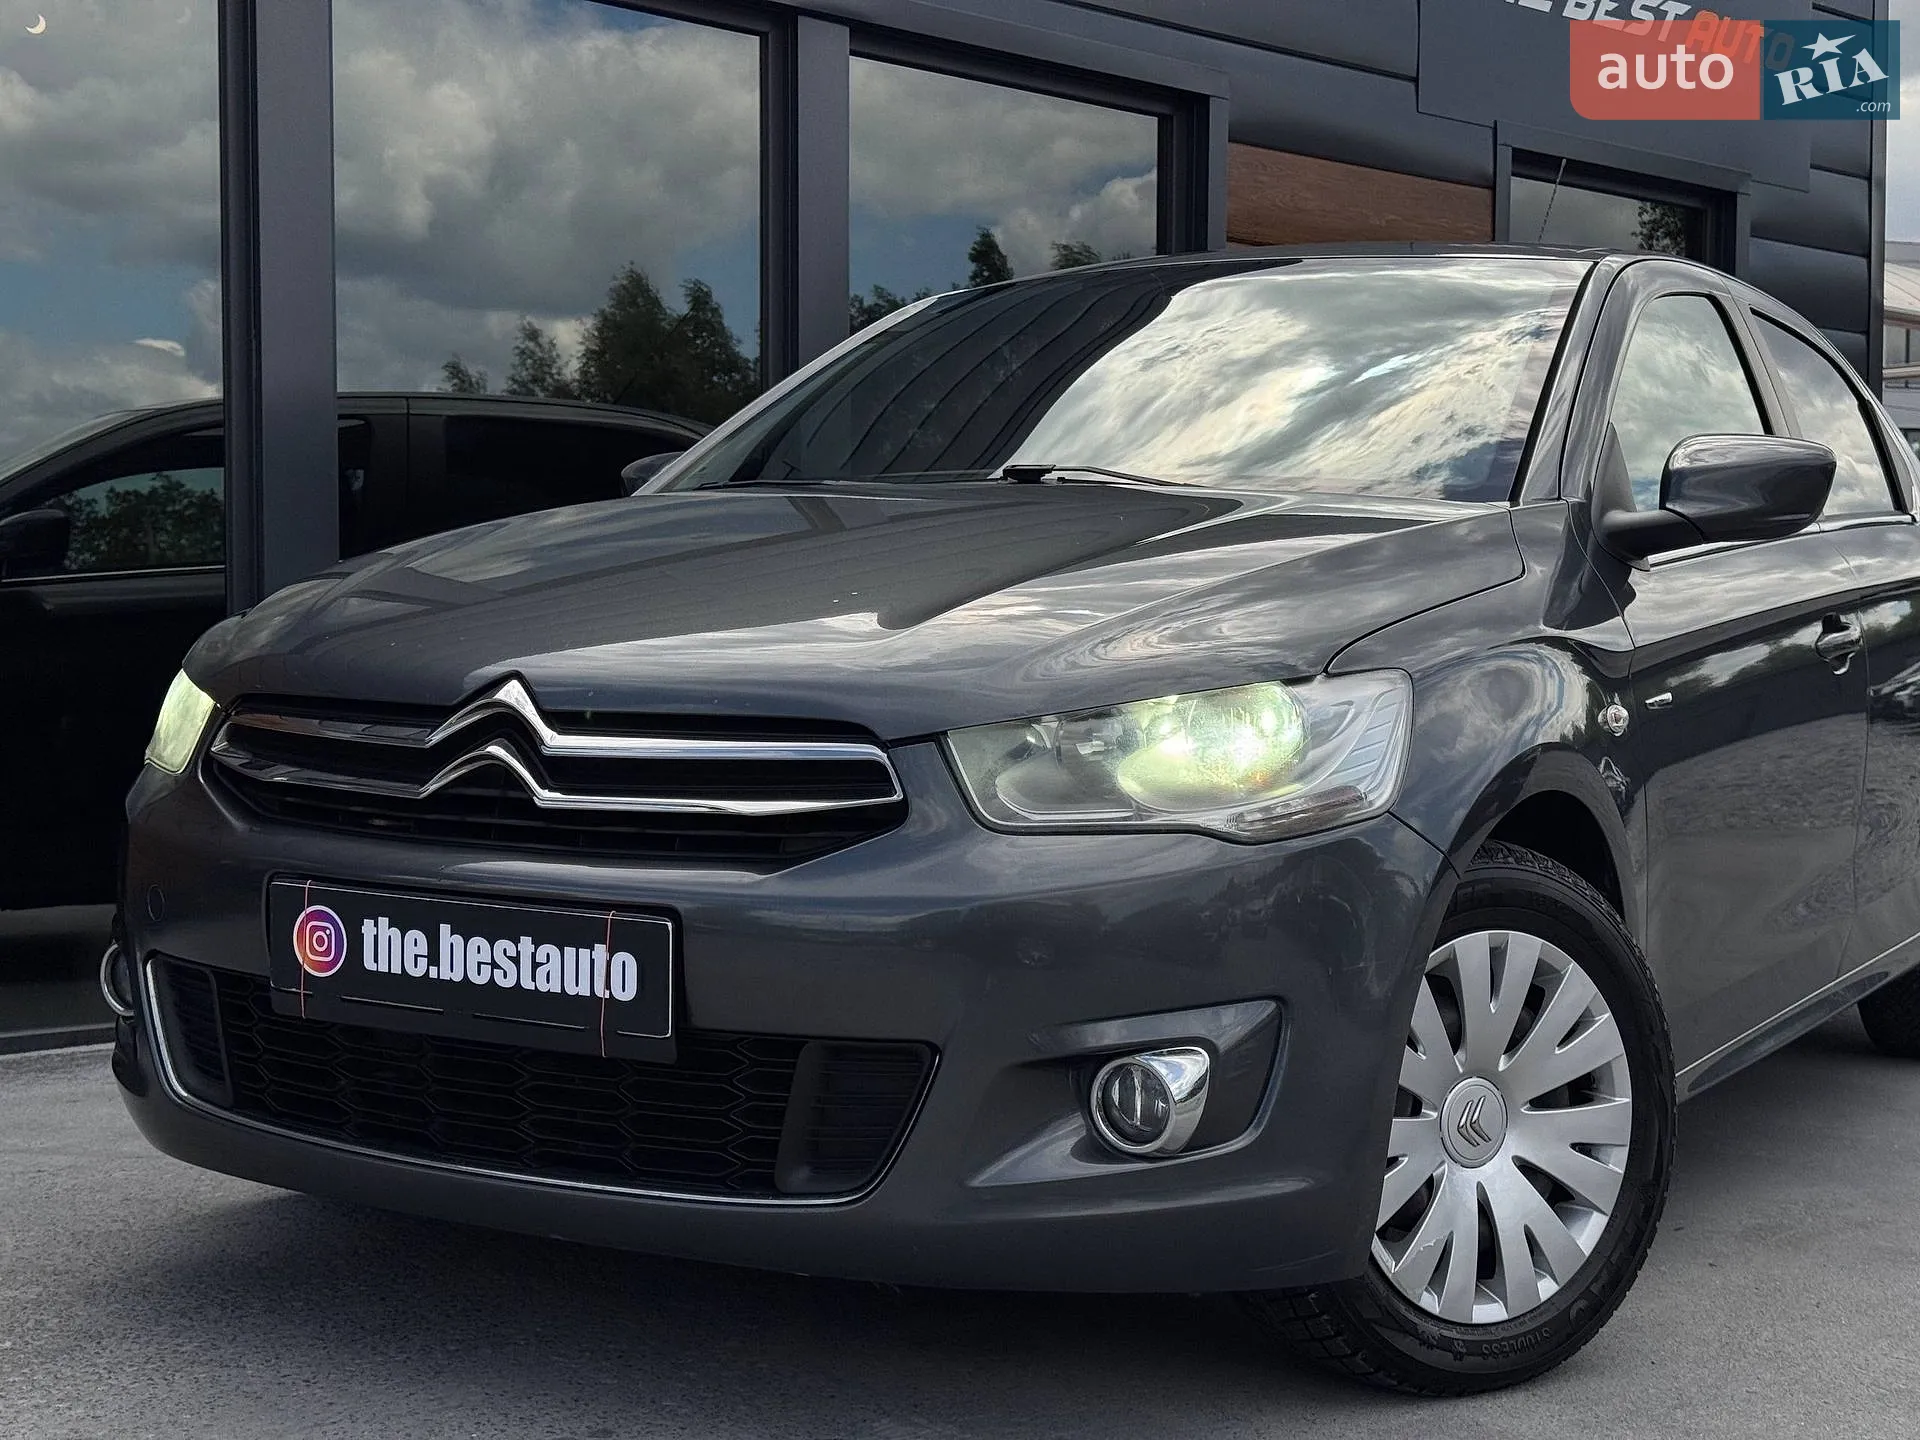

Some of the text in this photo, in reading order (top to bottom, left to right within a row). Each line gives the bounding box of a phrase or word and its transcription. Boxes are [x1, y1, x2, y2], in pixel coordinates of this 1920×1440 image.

[1561, 0, 1796, 71] BEST AUTO
[361, 916, 638, 1002] the.bestauto
